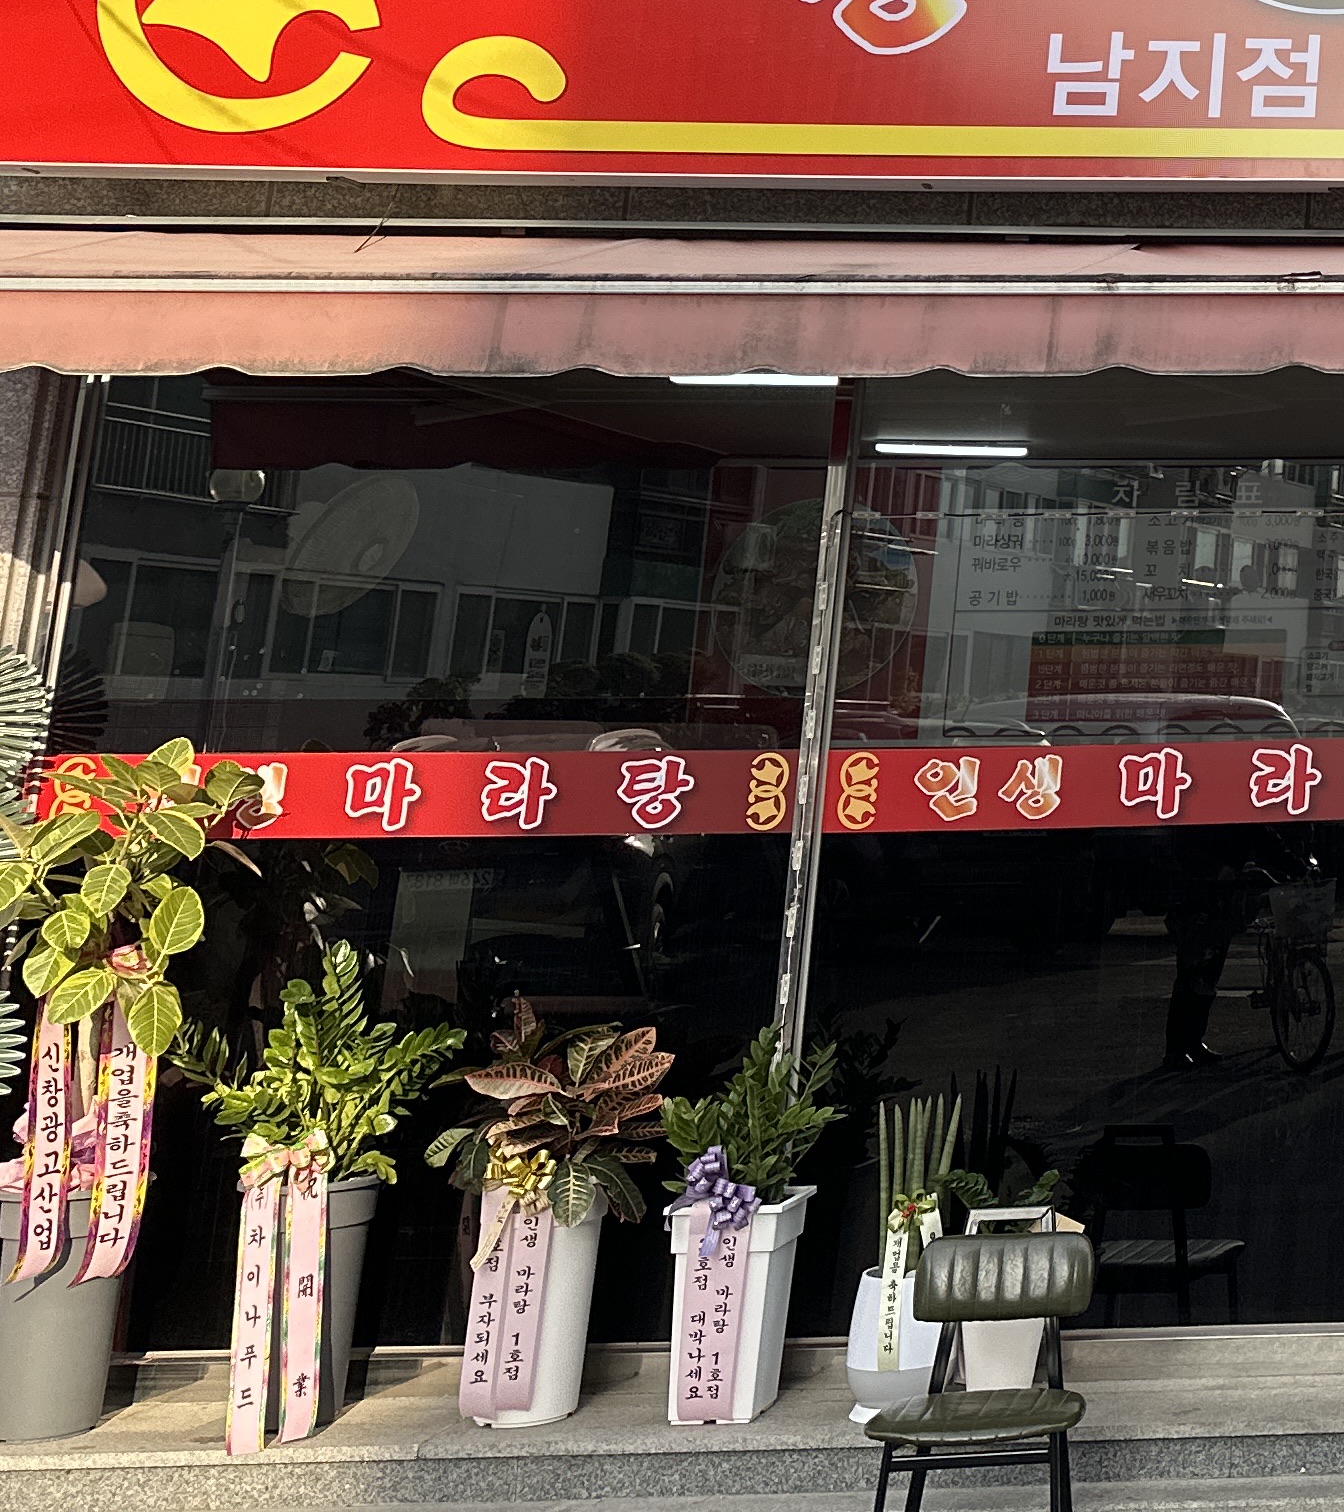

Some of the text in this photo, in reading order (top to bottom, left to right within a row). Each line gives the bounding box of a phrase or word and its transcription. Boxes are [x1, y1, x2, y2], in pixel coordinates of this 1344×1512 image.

[1046, 31, 1321, 118] 남지점
[345, 755, 694, 831] 마라탕
[914, 754, 1062, 822] 인생
[32, 1042, 64, 1251] 신창광고산업
[469, 1293, 498, 1385] 부자되세요
[503, 1216, 539, 1382] 인생 마라탕 1호점
[706, 1235, 738, 1400] 인생 마라탕 1호점
[685, 1310, 707, 1400] 대박나세요
